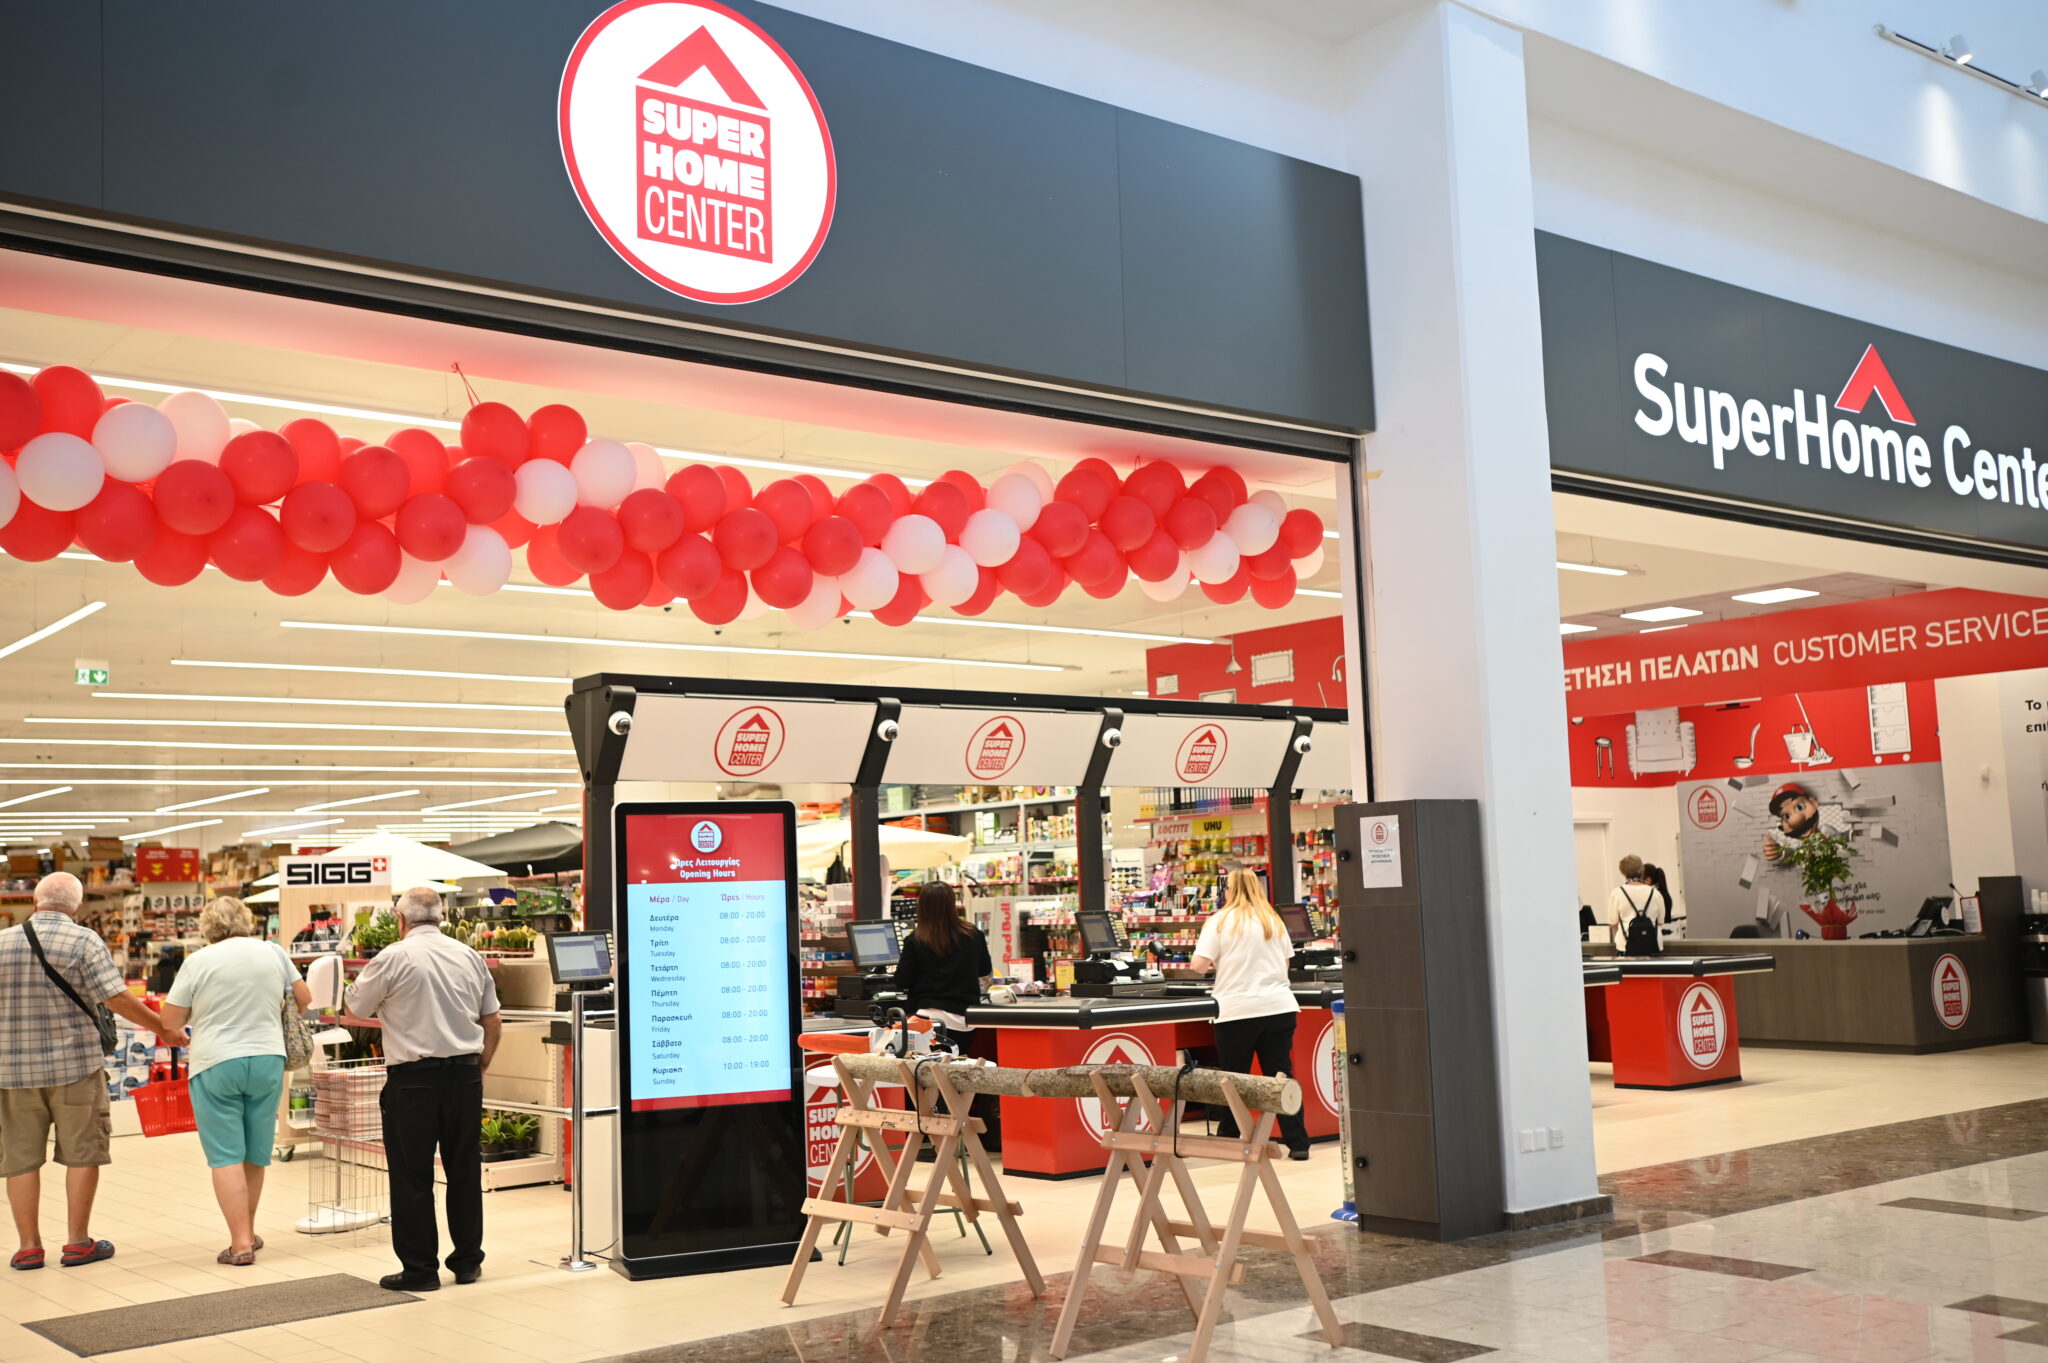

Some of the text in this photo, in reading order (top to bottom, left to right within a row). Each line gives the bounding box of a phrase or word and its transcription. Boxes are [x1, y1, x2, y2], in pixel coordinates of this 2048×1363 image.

[643, 98, 766, 159] SUPER
[643, 140, 766, 200] HOME
[644, 185, 766, 254] CENTER
[1634, 352, 1931, 488] SuperHome
[1774, 608, 2048, 666] CUSTOMER SERVICE
[1640, 645, 1759, 683] ΠΕΛΑΤΩΝ
[736, 733, 768, 742] SUPER
[733, 743, 766, 752] HOME
[985, 740, 1011, 748] SUPER
[1192, 745, 1215, 754] SUPER
[982, 748, 1009, 757] HOME
[1190, 754, 1213, 762] HOME
[730, 753, 763, 764] CENTER
[979, 758, 1006, 769] CENTER
[1186, 763, 1210, 772] CENTER
[1158, 823, 1189, 835] LOCTITE
[1203, 820, 1222, 832] UHU
[695, 857, 741, 869] Λειτουργίας
[287, 862, 371, 885] SIGG
[680, 869, 736, 880] Opening Hours
[649, 895, 670, 904] Μέρα
[677, 895, 690, 904] Day
[649, 914, 679, 922] Δευτέρα
[1000, 903, 1012, 962] Red Bull
[650, 939, 669, 948] Τρίτη
[650, 964, 679, 972] Τετάρτη
[651, 989, 678, 998] Πέμπτη
[651, 1013, 693, 1023] Παρασκευή
[721, 1011, 742, 1019] 08:00
[1692, 1014, 1714, 1026] SUPER
[1693, 1026, 1715, 1038] HOME
[652, 1040, 682, 1048] Σάββατο
[722, 1036, 742, 1044] 08:00
[1694, 1038, 1716, 1054] CENTER
[723, 1062, 743, 1070] 10:00
[809, 1124, 841, 1142] HOM
